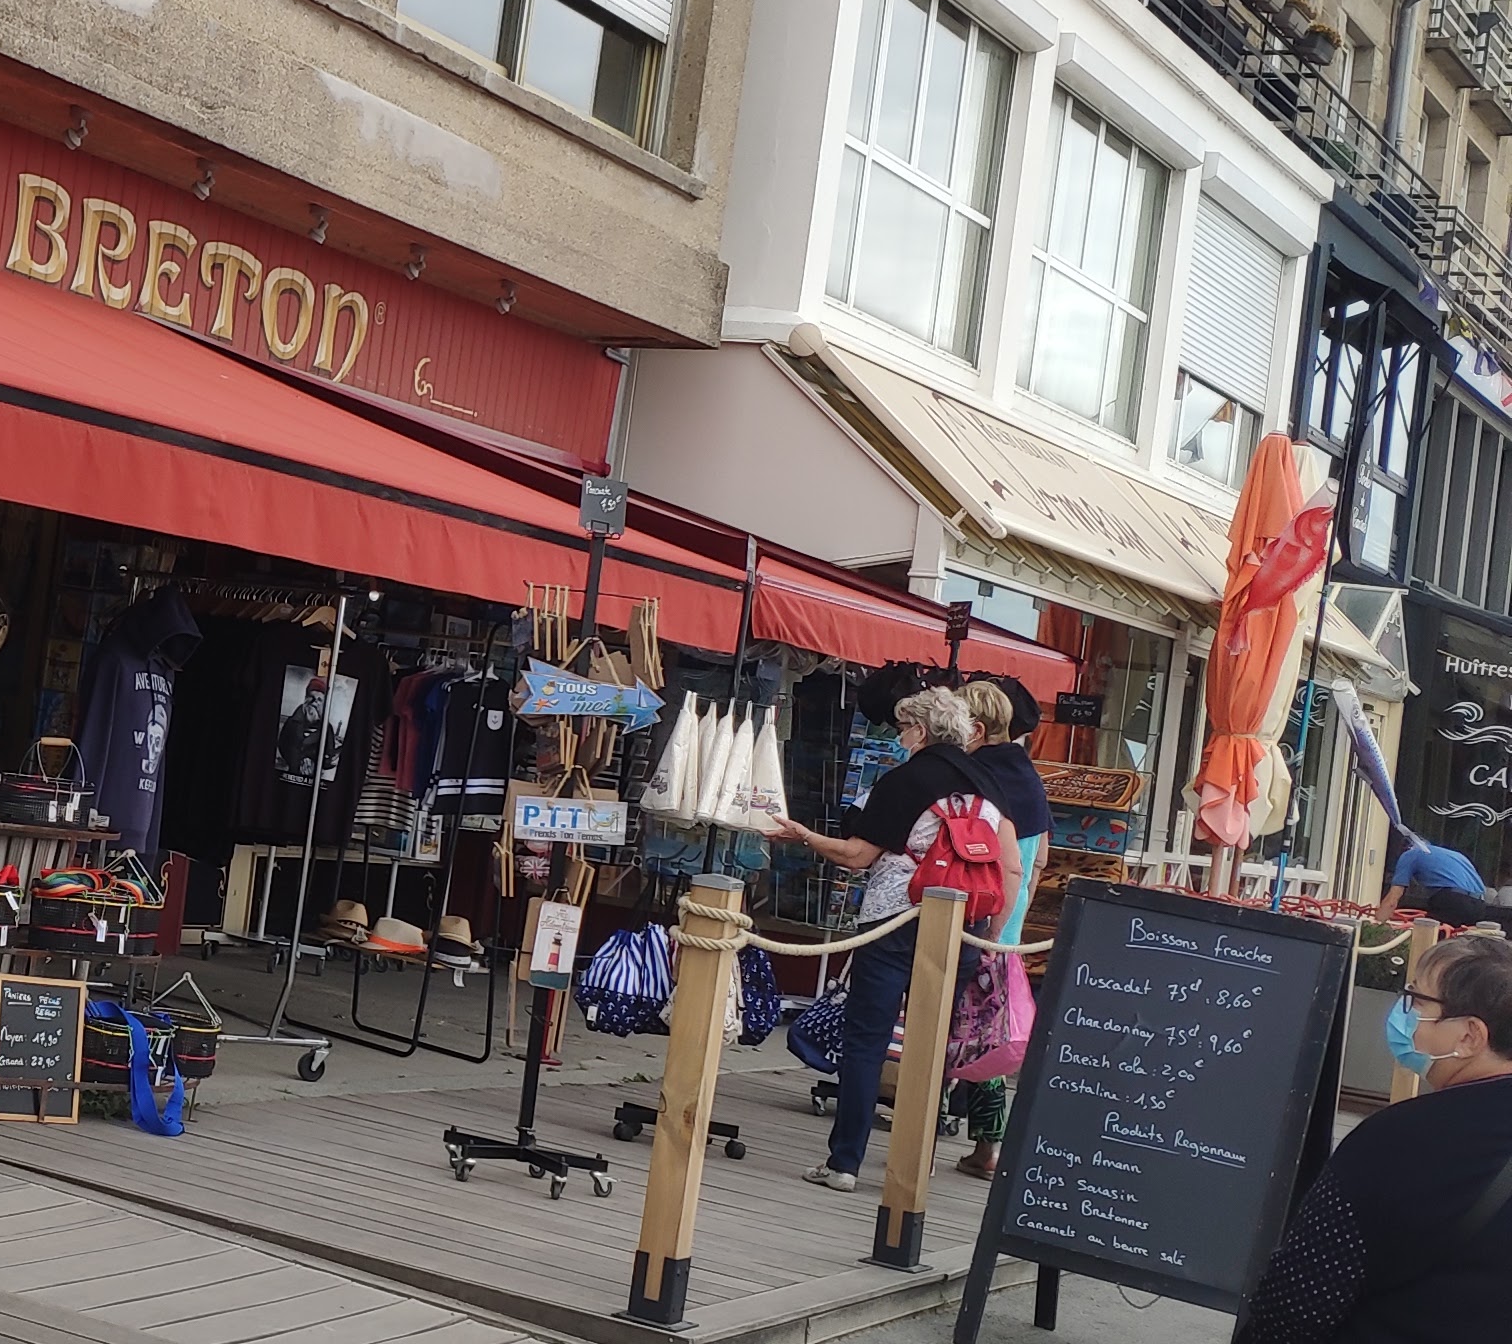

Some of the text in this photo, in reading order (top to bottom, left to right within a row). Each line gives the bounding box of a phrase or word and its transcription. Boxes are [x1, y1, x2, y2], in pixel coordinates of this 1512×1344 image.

[5, 173, 369, 382] BRETON
[556, 681, 598, 695] TOUS
[1468, 764, 1512, 791] CA
[529, 828, 557, 839] Prends
[560, 831, 575, 839] Ton
[1129, 917, 1199, 951] Boissons
[1075, 963, 1153, 995] Muscadet
[1063, 1007, 1155, 1047] Chardonnay
[1058, 1044, 1111, 1069] Breizh
[1048, 1075, 1123, 1102] Cristaline
[1104, 1111, 1165, 1144] Produits
[1035, 1135, 1142, 1174] Kouign Amann
[1025, 1165, 1065, 1190] Chips
[1023, 1188, 1149, 1231] Bières Bretonnes
[1016, 1213, 1186, 1266] Caramels au beurre salé
